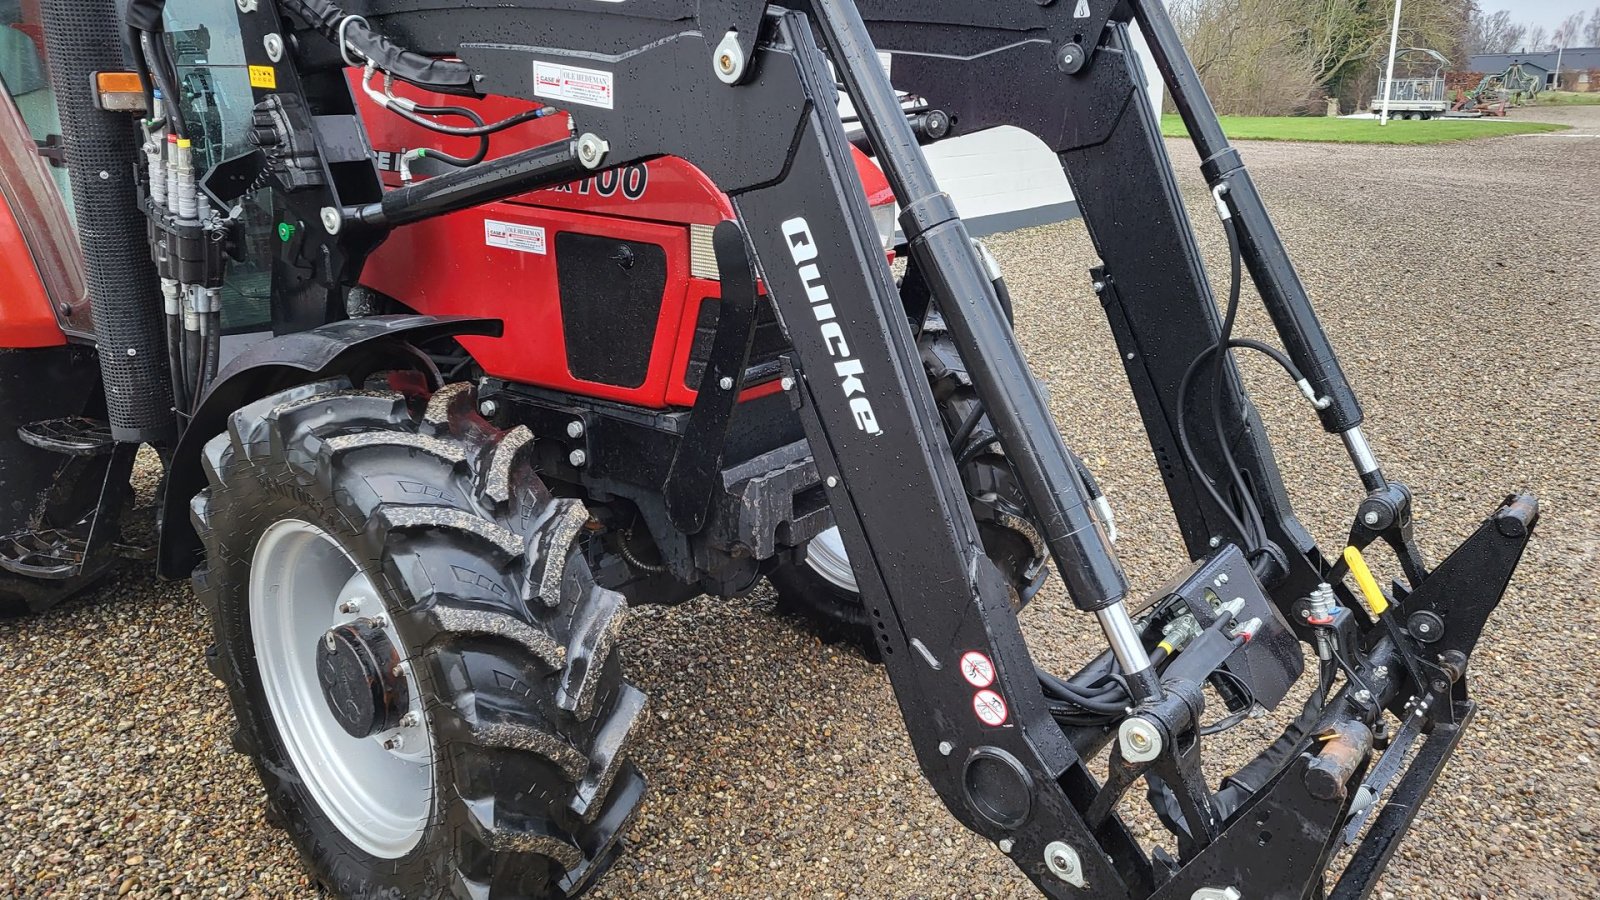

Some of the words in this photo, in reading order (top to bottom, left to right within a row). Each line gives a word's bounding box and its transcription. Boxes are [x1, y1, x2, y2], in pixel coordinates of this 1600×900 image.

[563, 71, 576, 81] OLE
[576, 72, 607, 86] HEDEMAN
[781, 216, 883, 436] Quicke
